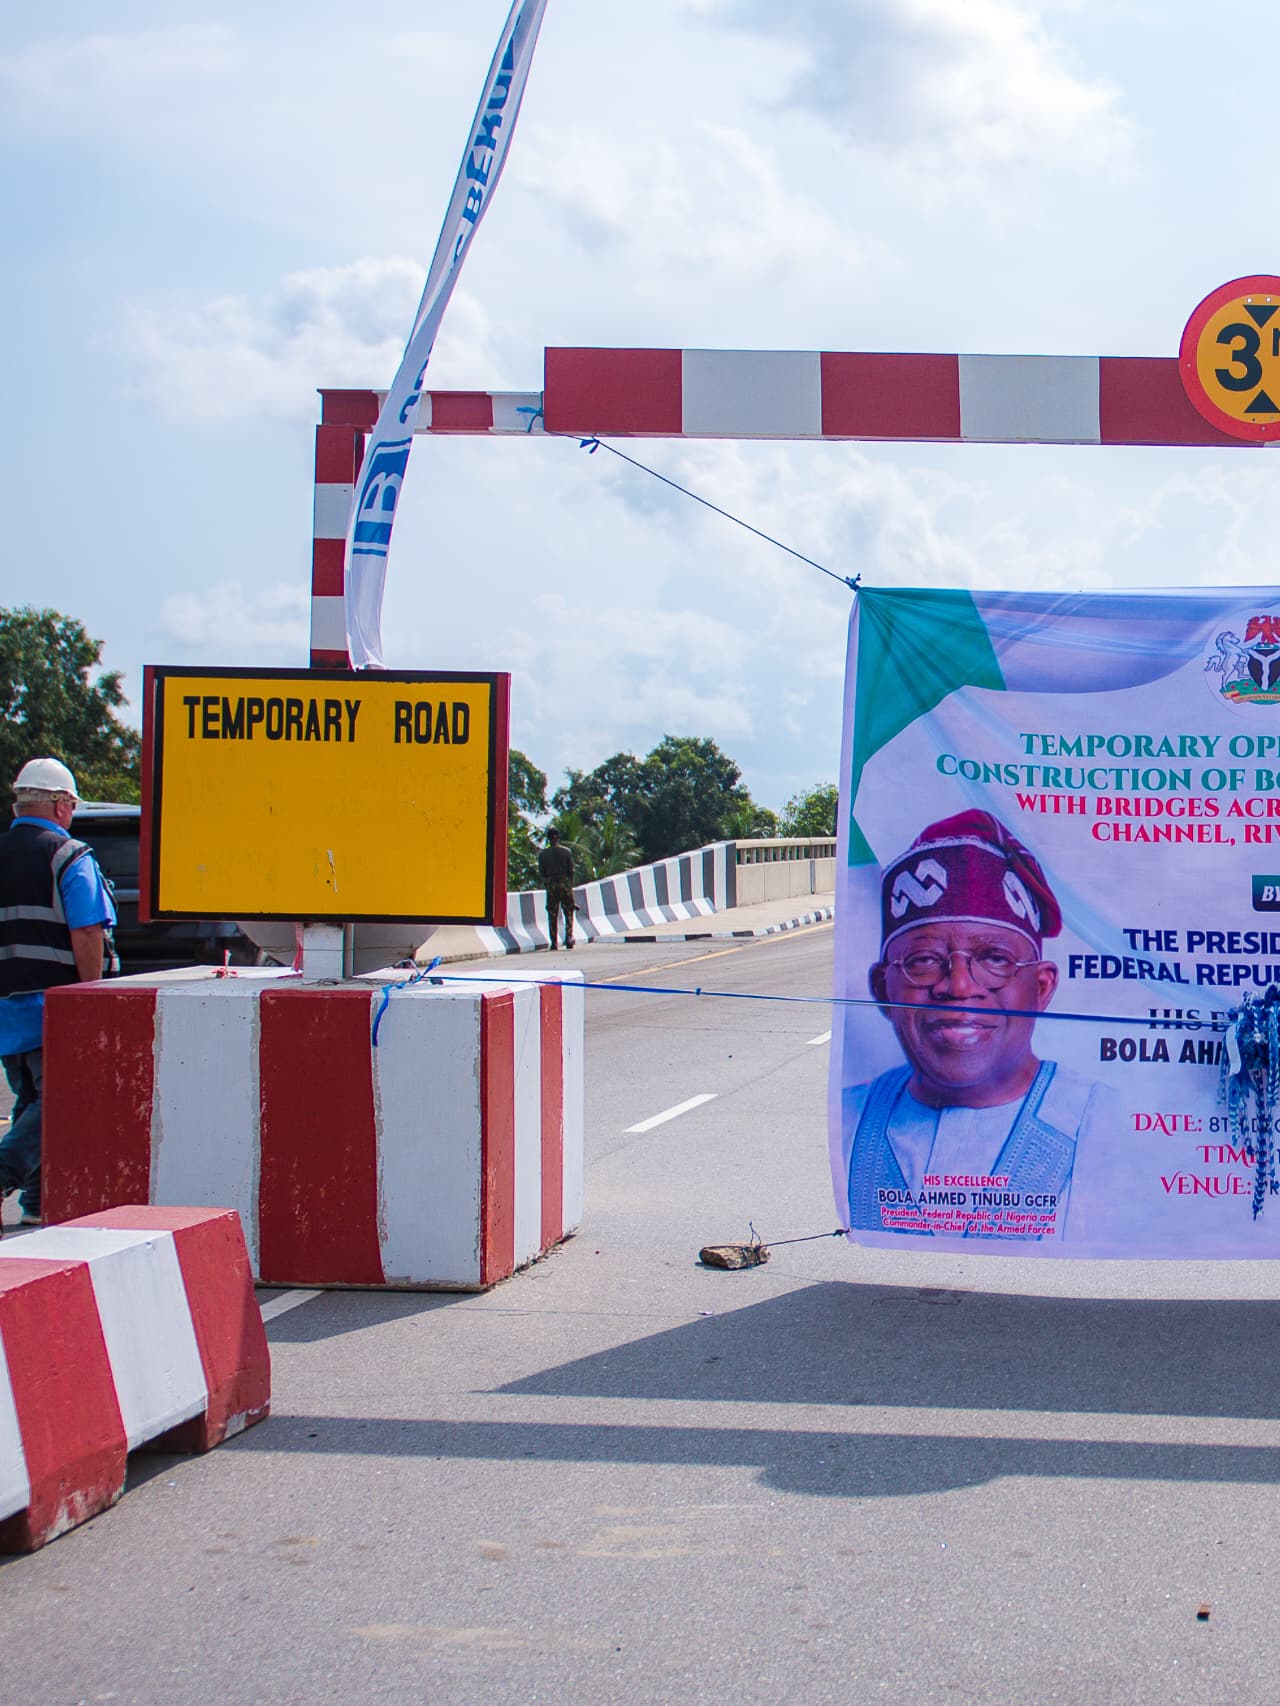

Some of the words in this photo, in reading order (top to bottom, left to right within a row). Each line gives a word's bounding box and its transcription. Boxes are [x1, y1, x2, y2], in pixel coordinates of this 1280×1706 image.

[183, 696, 361, 742] TEMPORARY
[394, 701, 470, 745] ROAD
[1020, 733, 1221, 758] TEMPORARY
[936, 754, 1192, 791] CONSTRUCTION
[1201, 768, 1246, 791] OF
[1016, 793, 1087, 816] WITH
[1095, 797, 1219, 818] BRIDGES
[1091, 822, 1236, 846] CHANNEL,
[1123, 928, 1179, 952] THE
[1068, 954, 1190, 985] FEDERAL
[1148, 1008, 1203, 1031] HIS
[1100, 1037, 1170, 1063] BOLA
[1130, 1112, 1203, 1136] DATE:
[924, 1176, 940, 1186] HIS
[944, 1176, 1009, 1187] EXCELLENCY
[1159, 1170, 1251, 1199] VENUE:
[879, 1189, 914, 1204] BOLA
[918, 1191, 967, 1205] AHMED
[971, 1193, 1020, 1206] TINUBU
[1025, 1195, 1057, 1207] GCFR
[881, 1207, 920, 1218] President,
[922, 1209, 953, 1219] Federal
[956, 1210, 991, 1222] Republic
[994, 1211, 1003, 1220] of
[1006, 1212, 1037, 1223] Nigeria
[1040, 1212, 1056, 1222] and
[883, 1217, 966, 1231] Commander-in-Chief
[969, 1222, 977, 1232] of
[981, 1223, 994, 1232] the
[997, 1224, 1025, 1233] Armed
[1028, 1224, 1055, 1234] Forces
